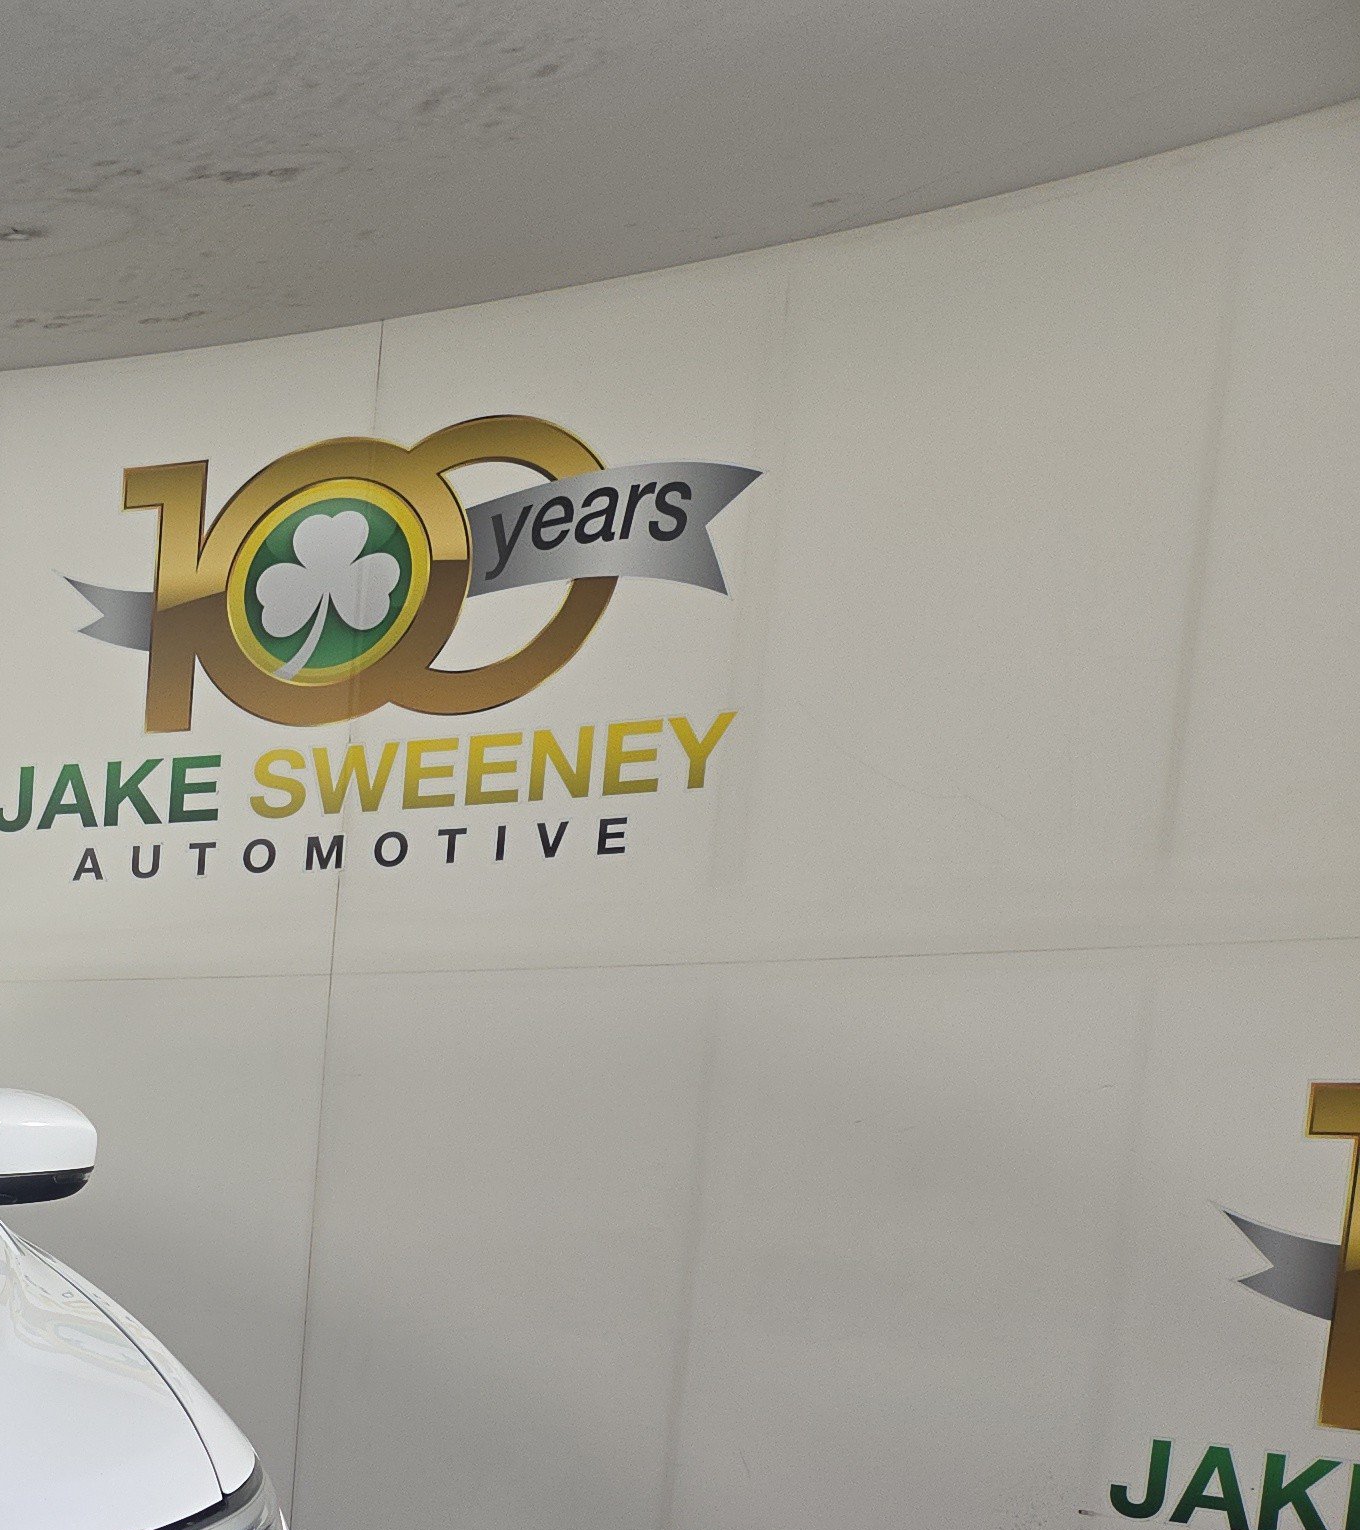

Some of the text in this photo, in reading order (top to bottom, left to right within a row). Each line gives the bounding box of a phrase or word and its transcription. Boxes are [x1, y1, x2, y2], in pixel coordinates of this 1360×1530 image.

[484, 479, 692, 581] years
[248, 710, 738, 819] SWEENEY
[72, 816, 629, 882] AUTOMOTIVE
